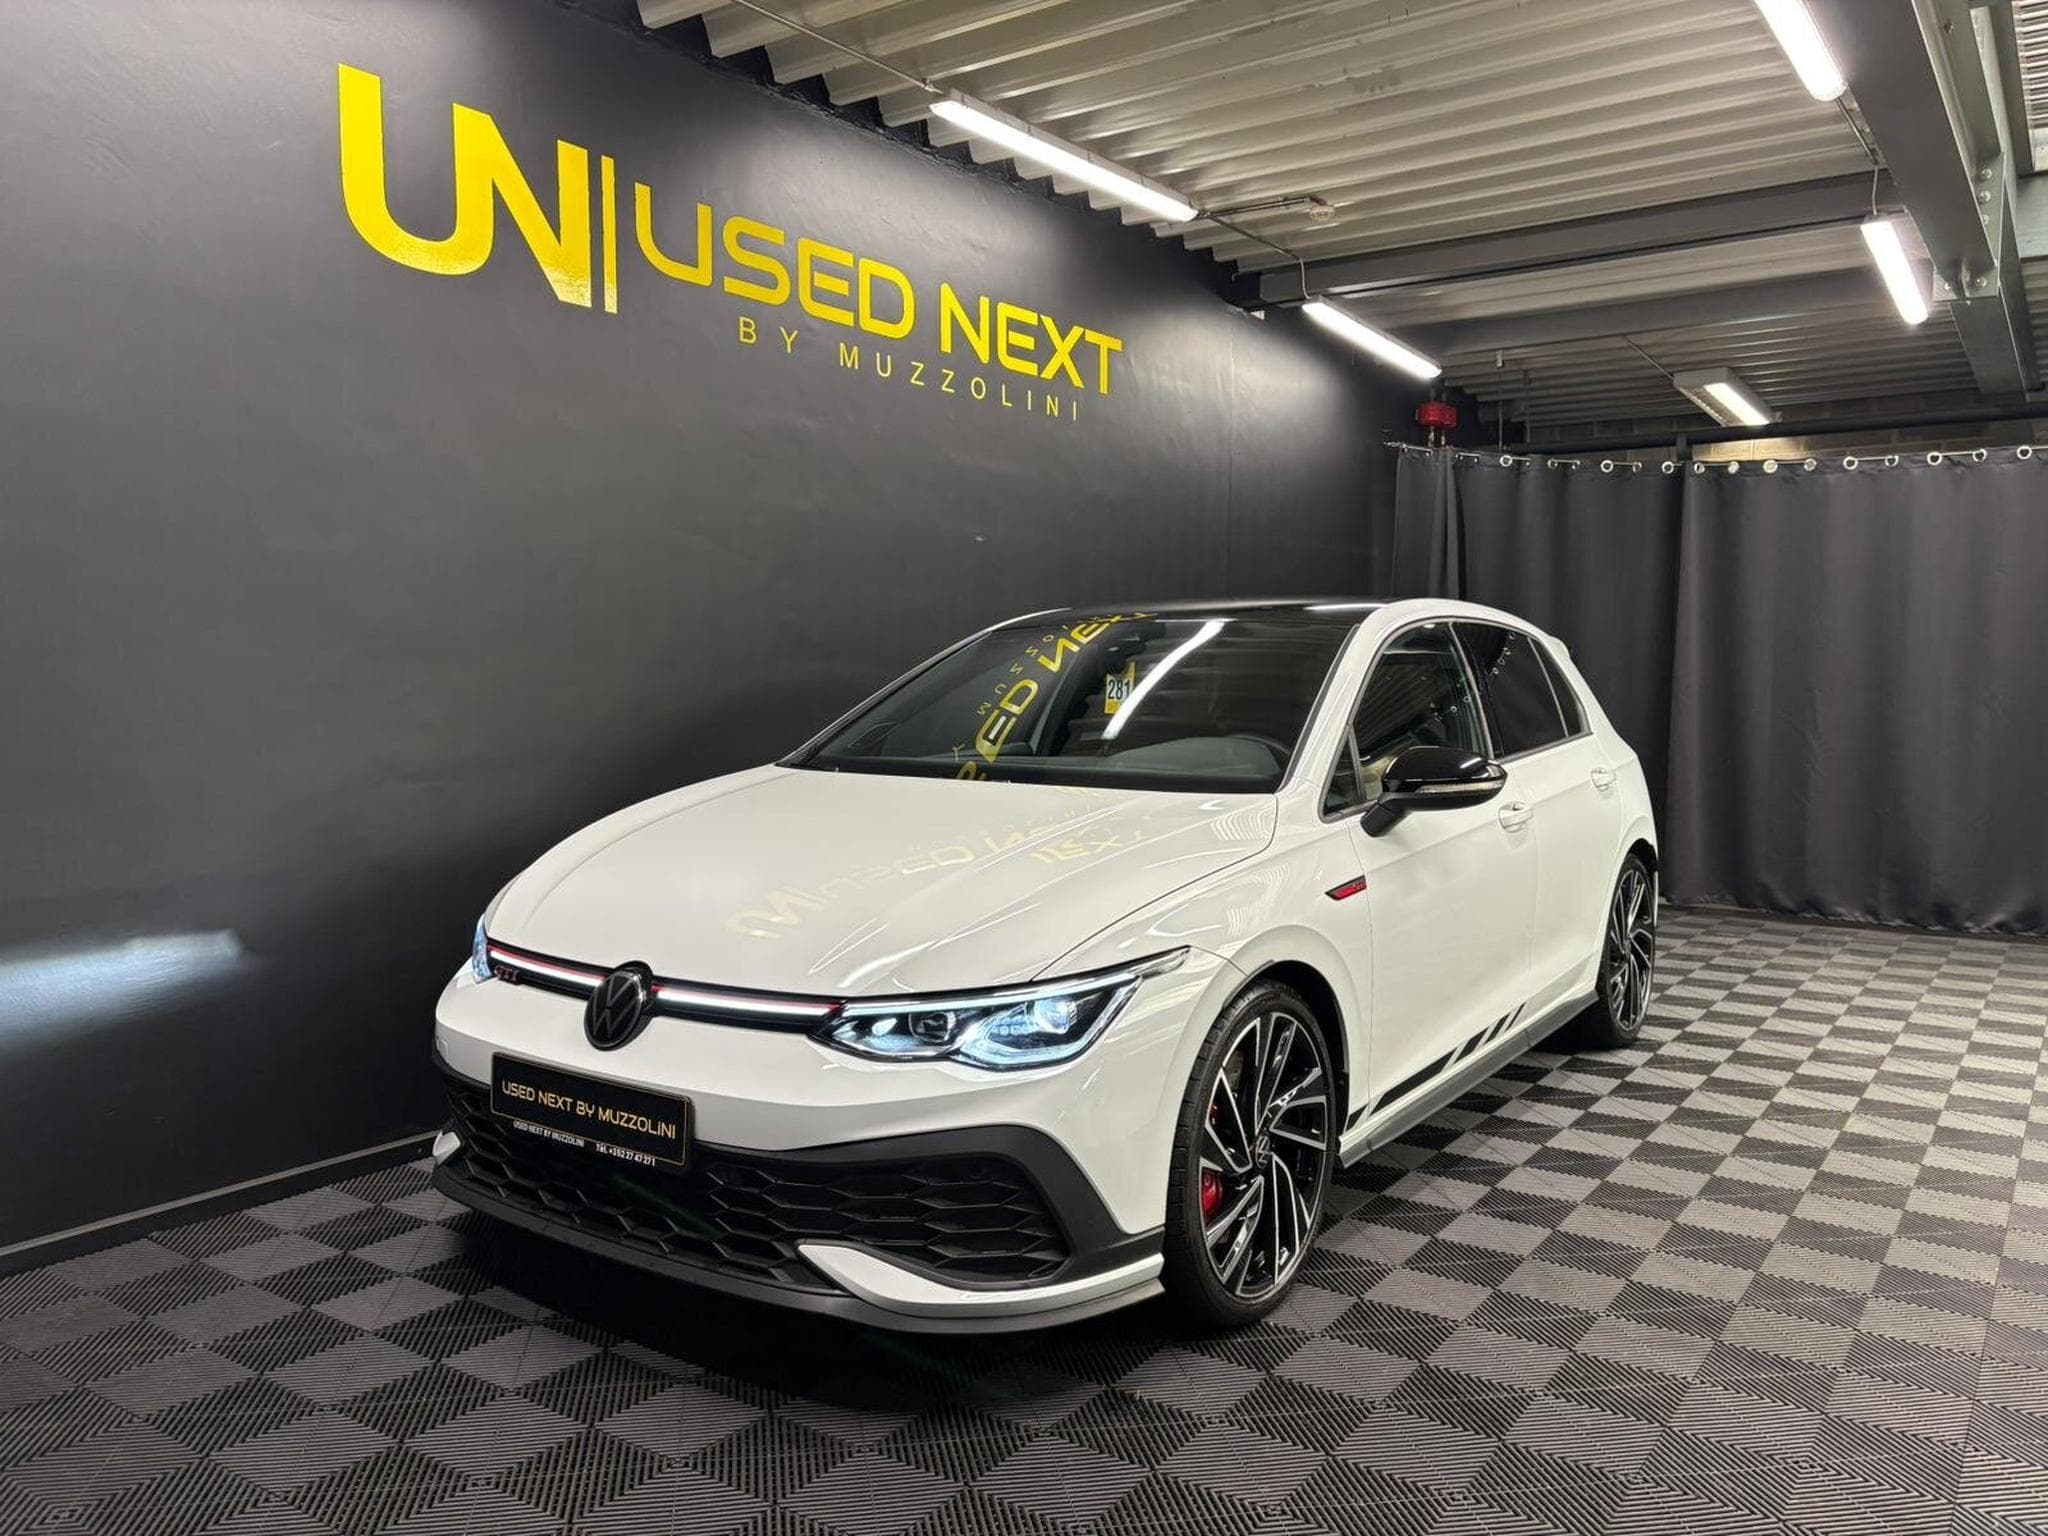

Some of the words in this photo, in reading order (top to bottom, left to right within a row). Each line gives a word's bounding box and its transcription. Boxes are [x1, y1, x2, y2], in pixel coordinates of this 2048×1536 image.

[633, 182, 916, 340] USED
[939, 282, 1123, 395] NEXT
[738, 316, 798, 354] BY
[838, 341, 1080, 421] MUZZOLINI
[501, 1079, 536, 1102] USED
[538, 1090, 574, 1113] NEXT
[576, 1101, 596, 1118] BY
[598, 1106, 677, 1140] MUZZOLINI
